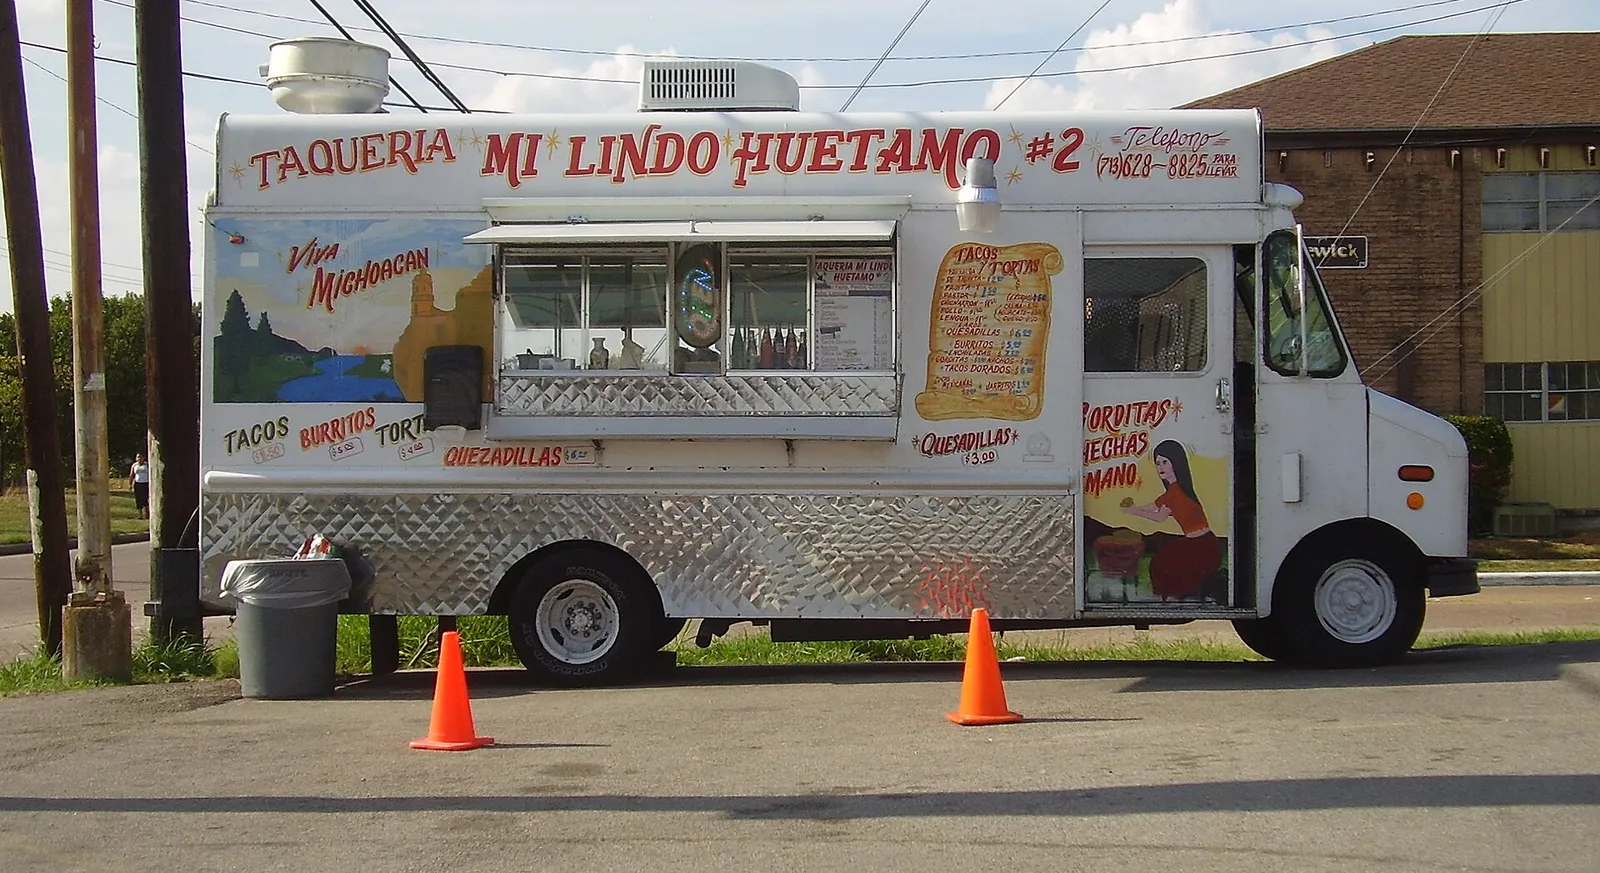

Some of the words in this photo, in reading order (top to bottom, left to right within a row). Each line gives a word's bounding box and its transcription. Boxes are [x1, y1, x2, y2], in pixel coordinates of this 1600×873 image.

[1122, 126, 1226, 153] Telefono
[248, 128, 457, 190] TAQUERIA
[480, 131, 543, 189] MI
[563, 123, 721, 184] LINDO
[731, 127, 1002, 192] HUETAMO
[1024, 126, 1085, 174] #2
[1212, 154, 1237, 164] PARA
[1205, 165, 1238, 178] LLEVAR
[954, 246, 998, 263] TACOS
[855, 261, 868, 270] MI
[988, 258, 1041, 281] TORTAS
[833, 272, 875, 281] HUETAMO
[940, 314, 969, 322] LENGUA
[946, 327, 1001, 338] QUESADILLAS
[954, 340, 994, 350] BURRITOS
[944, 364, 969, 373] TACOS
[970, 364, 1012, 375] DORADOS
[223, 415, 290, 457] TACOS
[299, 406, 376, 451] BURRITOS
[375, 413, 426, 447] TORT
[920, 427, 1012, 457] QUESADILLAS
[443, 446, 562, 467] QUEZADILLAS
